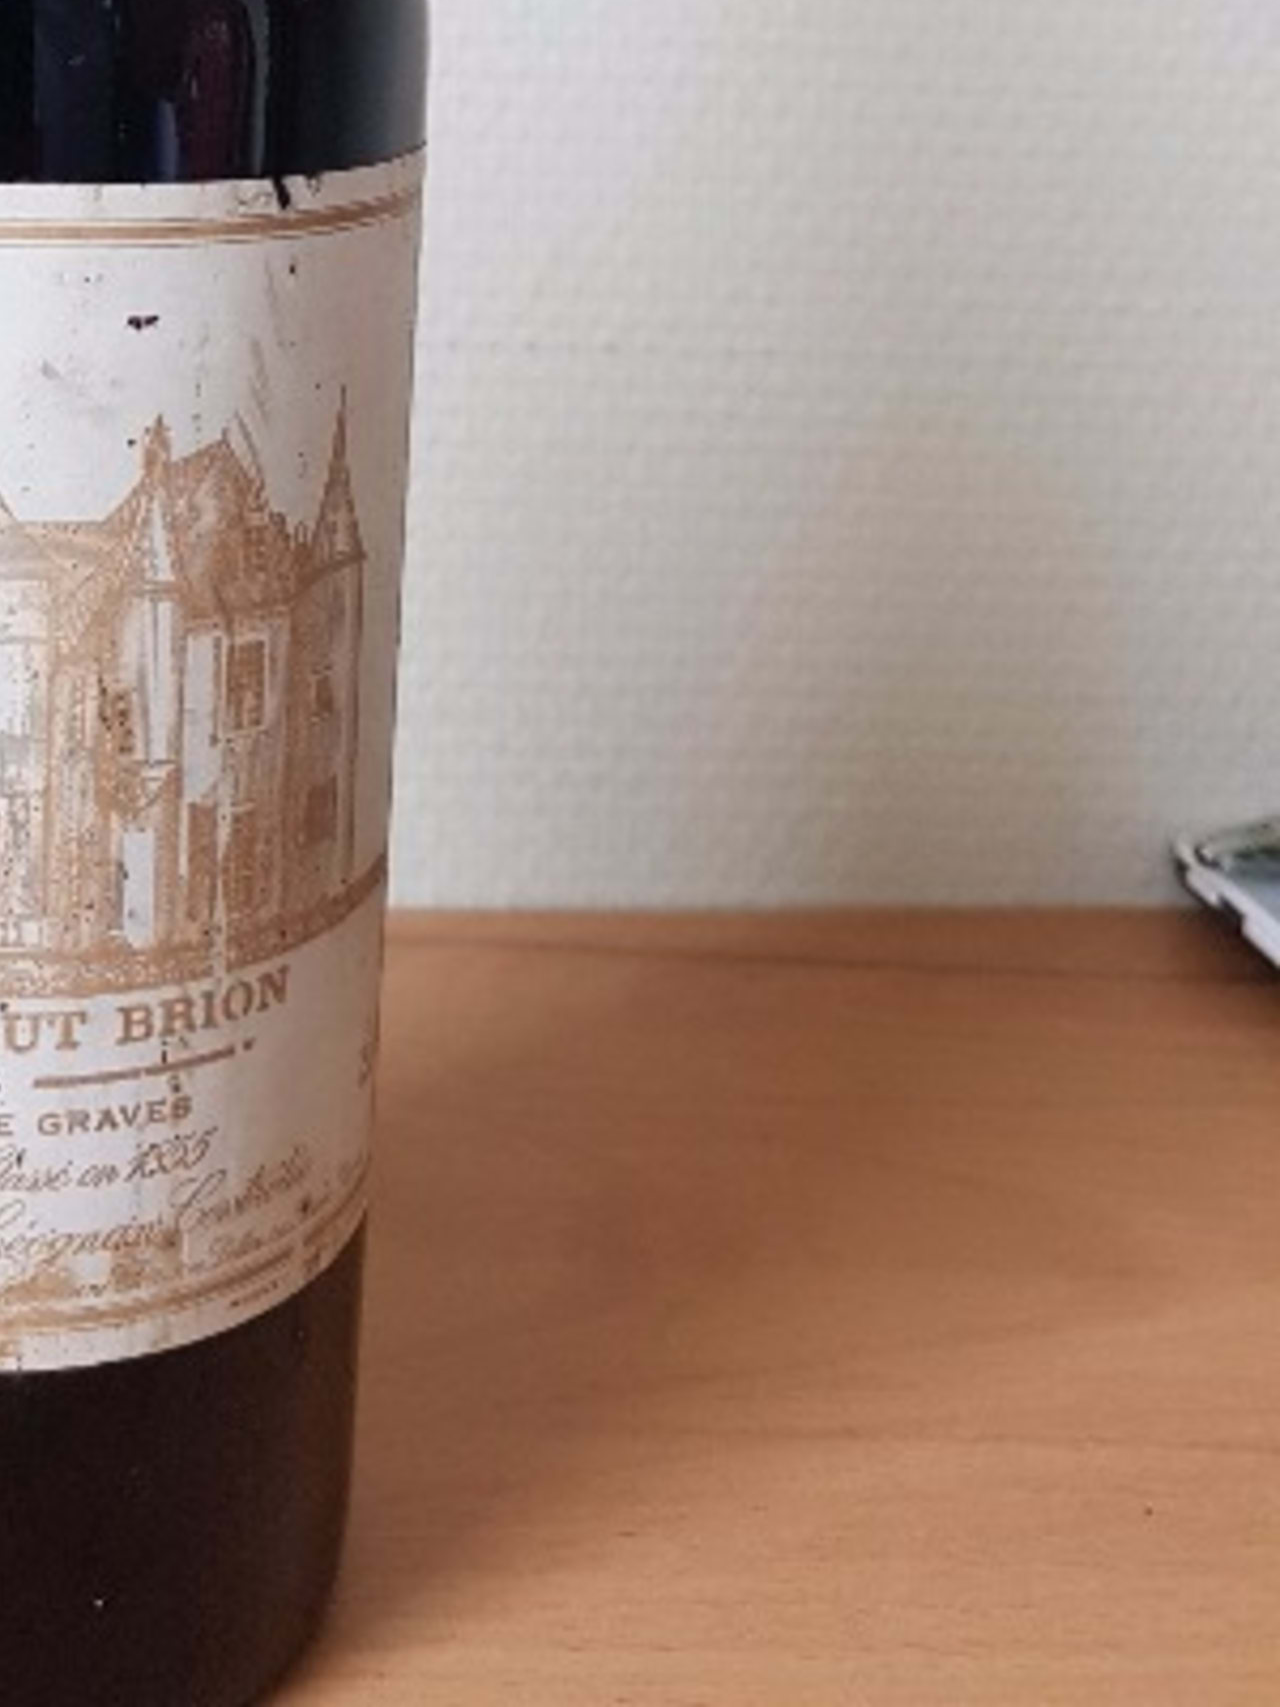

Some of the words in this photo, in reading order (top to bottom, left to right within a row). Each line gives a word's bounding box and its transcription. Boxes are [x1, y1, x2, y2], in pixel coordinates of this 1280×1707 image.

[116, 964, 292, 1047] BRION
[36, 1096, 194, 1136] GRAVES
[77, 1163, 120, 1188] en
[123, 1125, 220, 1182] 1855
